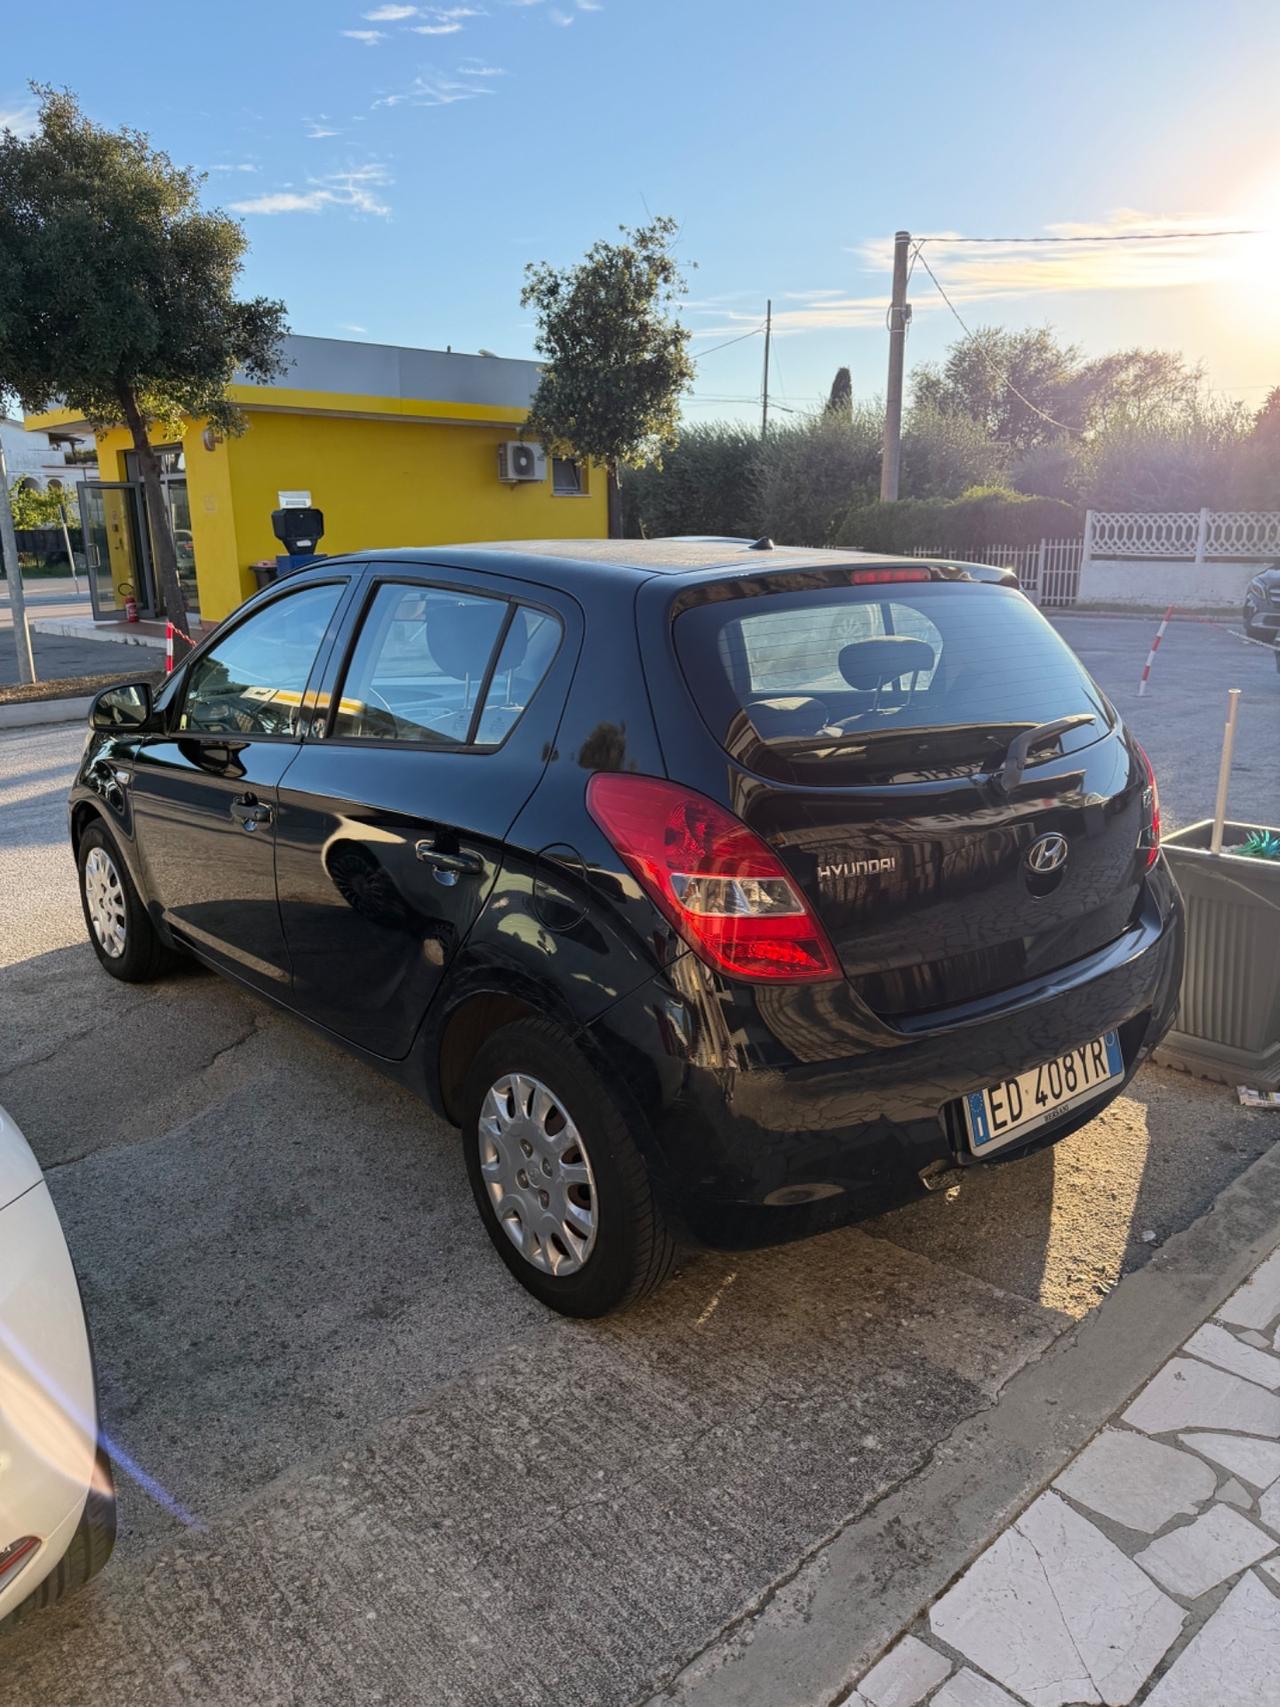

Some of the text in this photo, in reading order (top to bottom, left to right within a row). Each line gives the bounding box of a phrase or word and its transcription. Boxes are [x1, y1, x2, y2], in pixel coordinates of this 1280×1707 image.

[817, 857, 895, 880] HYUNDAI
[988, 1041, 1107, 1131] ED 408YR
